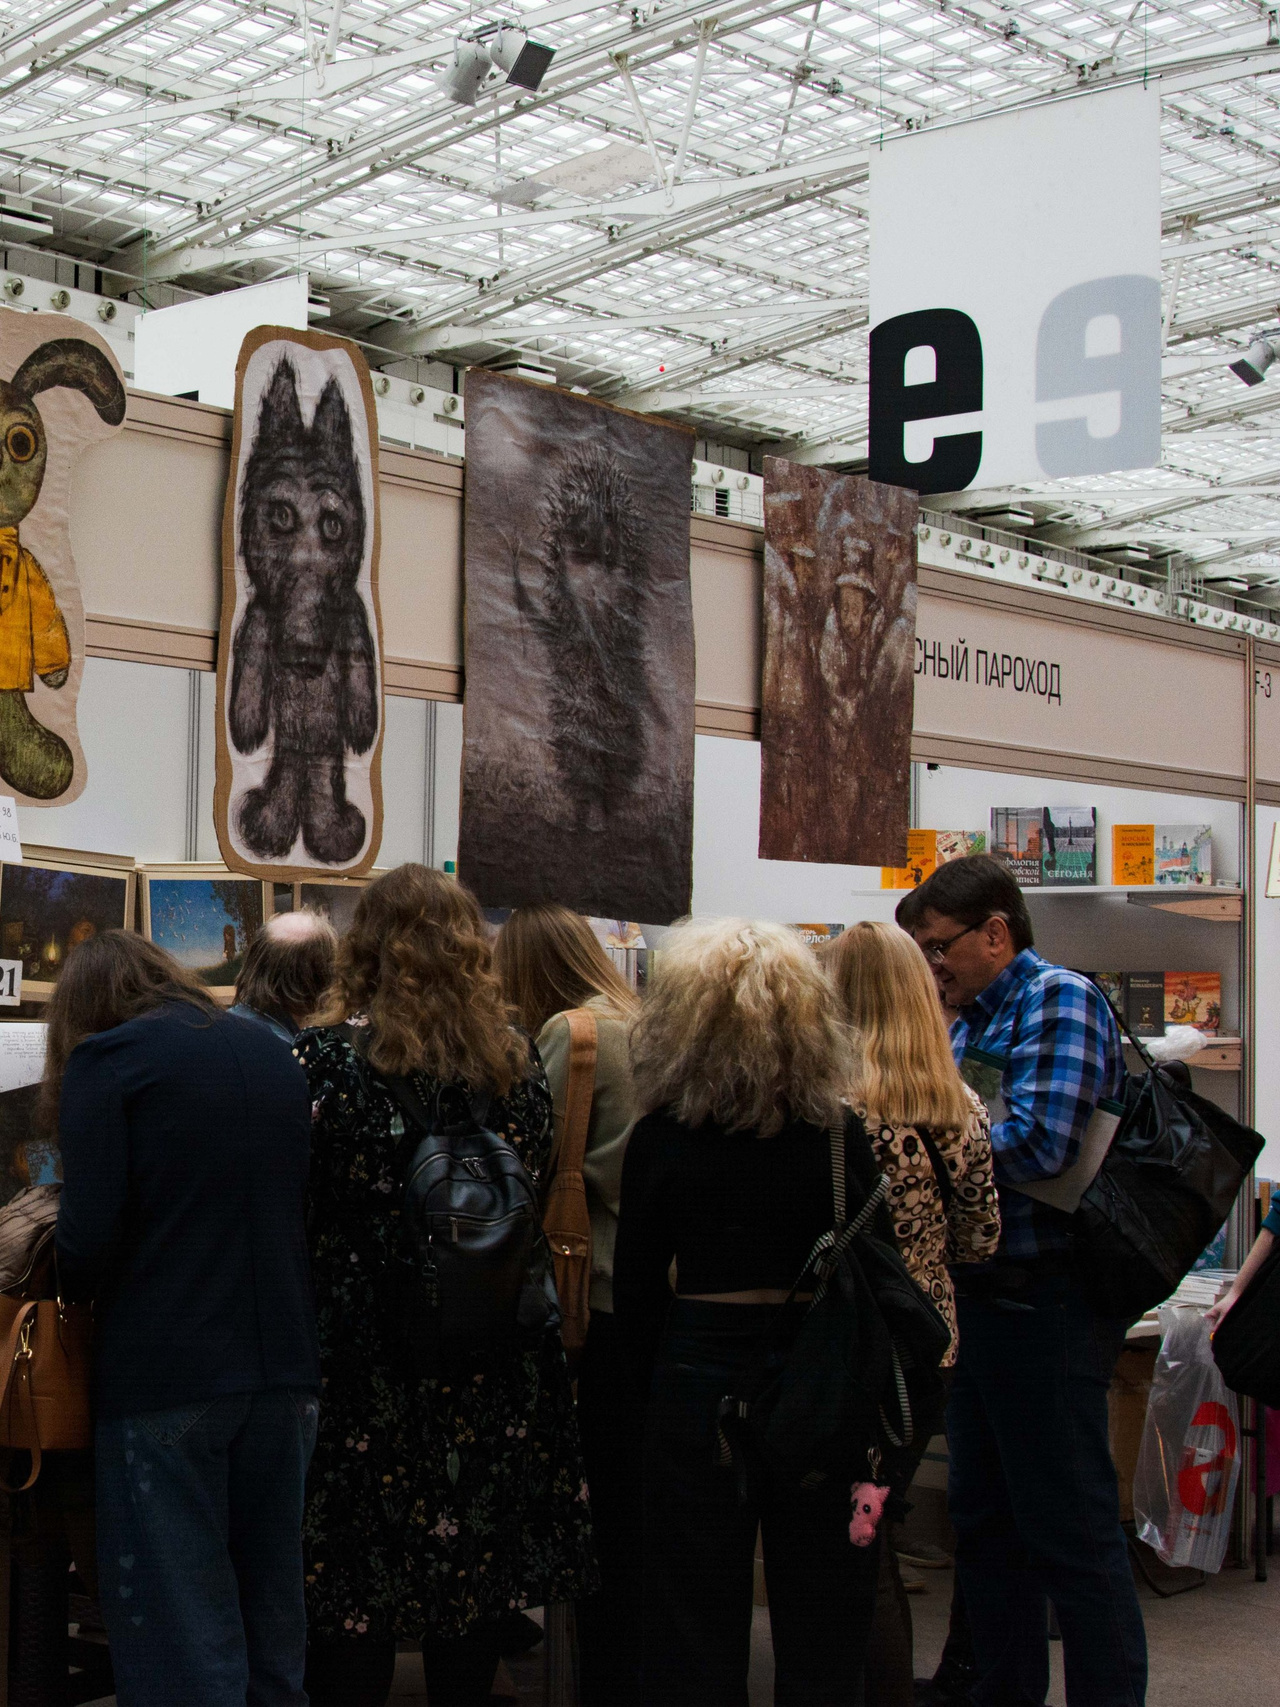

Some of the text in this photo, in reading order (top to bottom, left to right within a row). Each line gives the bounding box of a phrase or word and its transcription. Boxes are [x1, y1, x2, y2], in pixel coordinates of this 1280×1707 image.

[914, 637, 1062, 706] СНЫЙ ПАРОХОД
[1255, 670, 1271, 698] F-3
[1011, 866, 1039, 876] овской
[1047, 869, 1093, 879] СЕГОДНЯ
